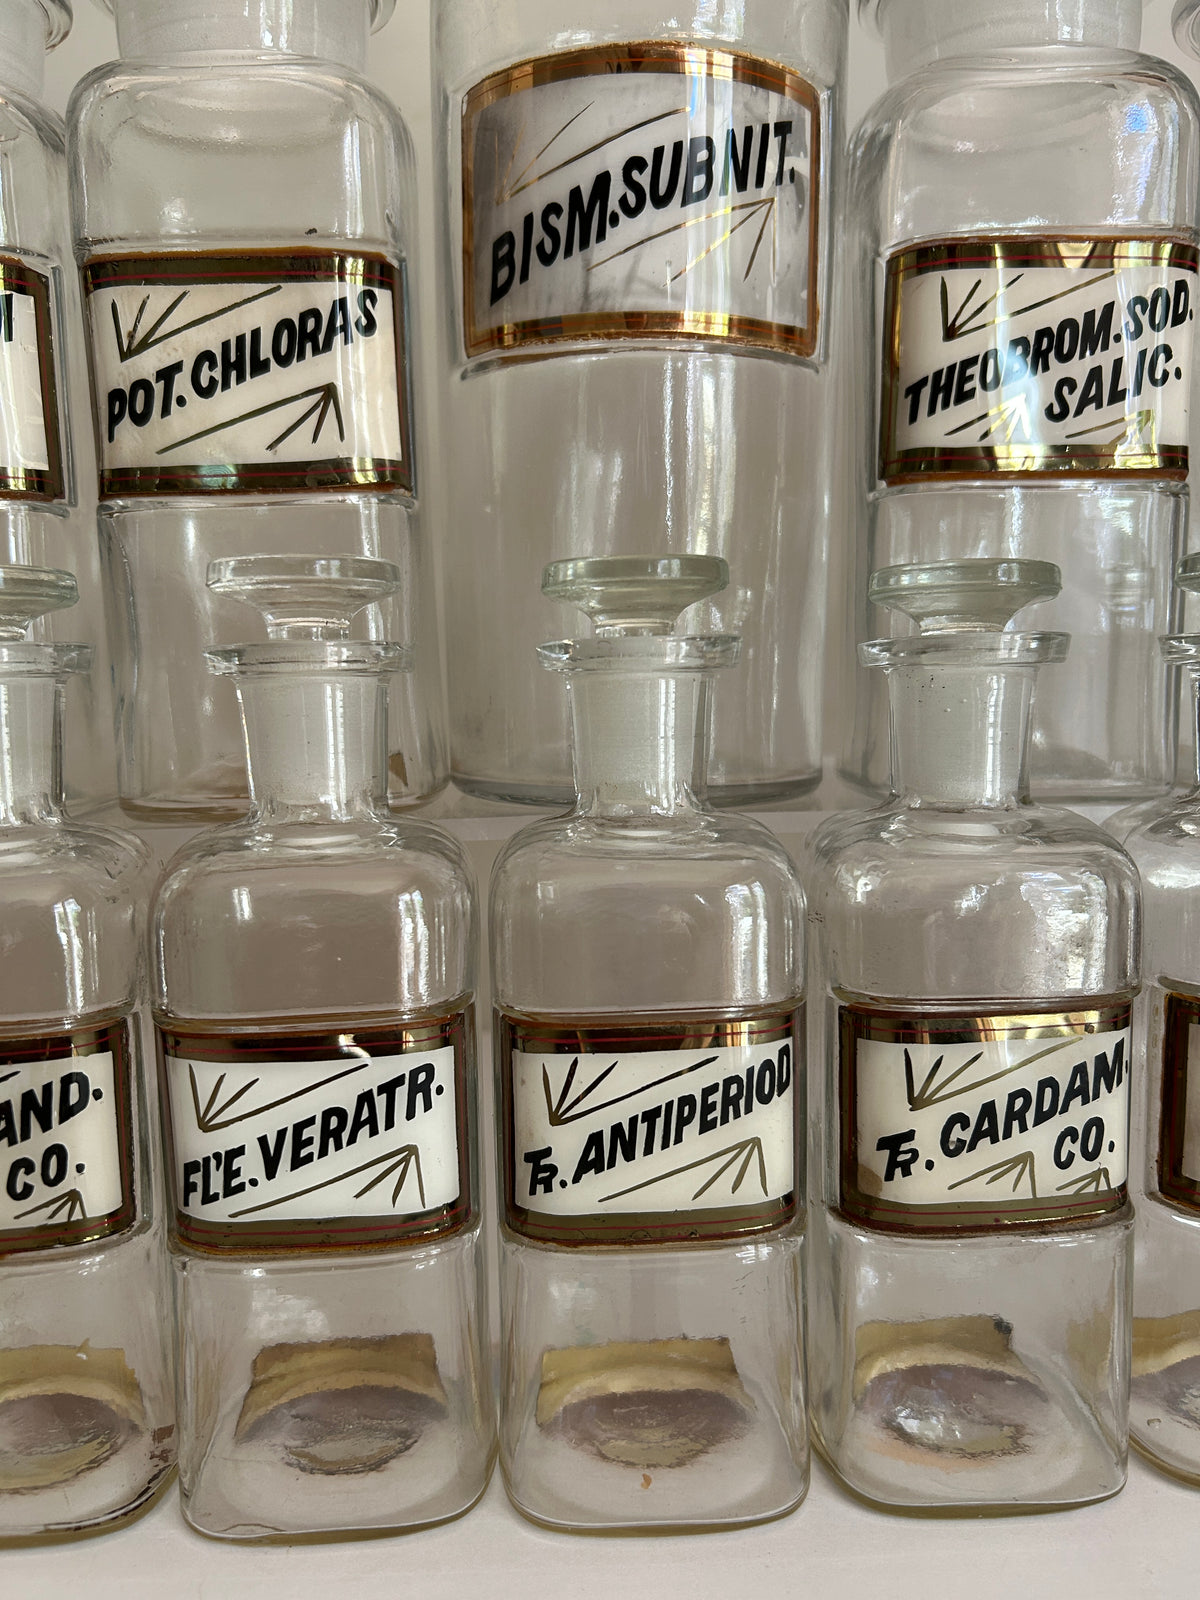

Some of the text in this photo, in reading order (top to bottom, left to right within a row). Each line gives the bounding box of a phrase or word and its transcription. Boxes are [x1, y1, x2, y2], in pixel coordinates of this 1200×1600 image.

[1044, 344, 1182, 422] SALIC.
[6, 1143, 85, 1201] CO.
[1053, 1116, 1116, 1170] CO.
